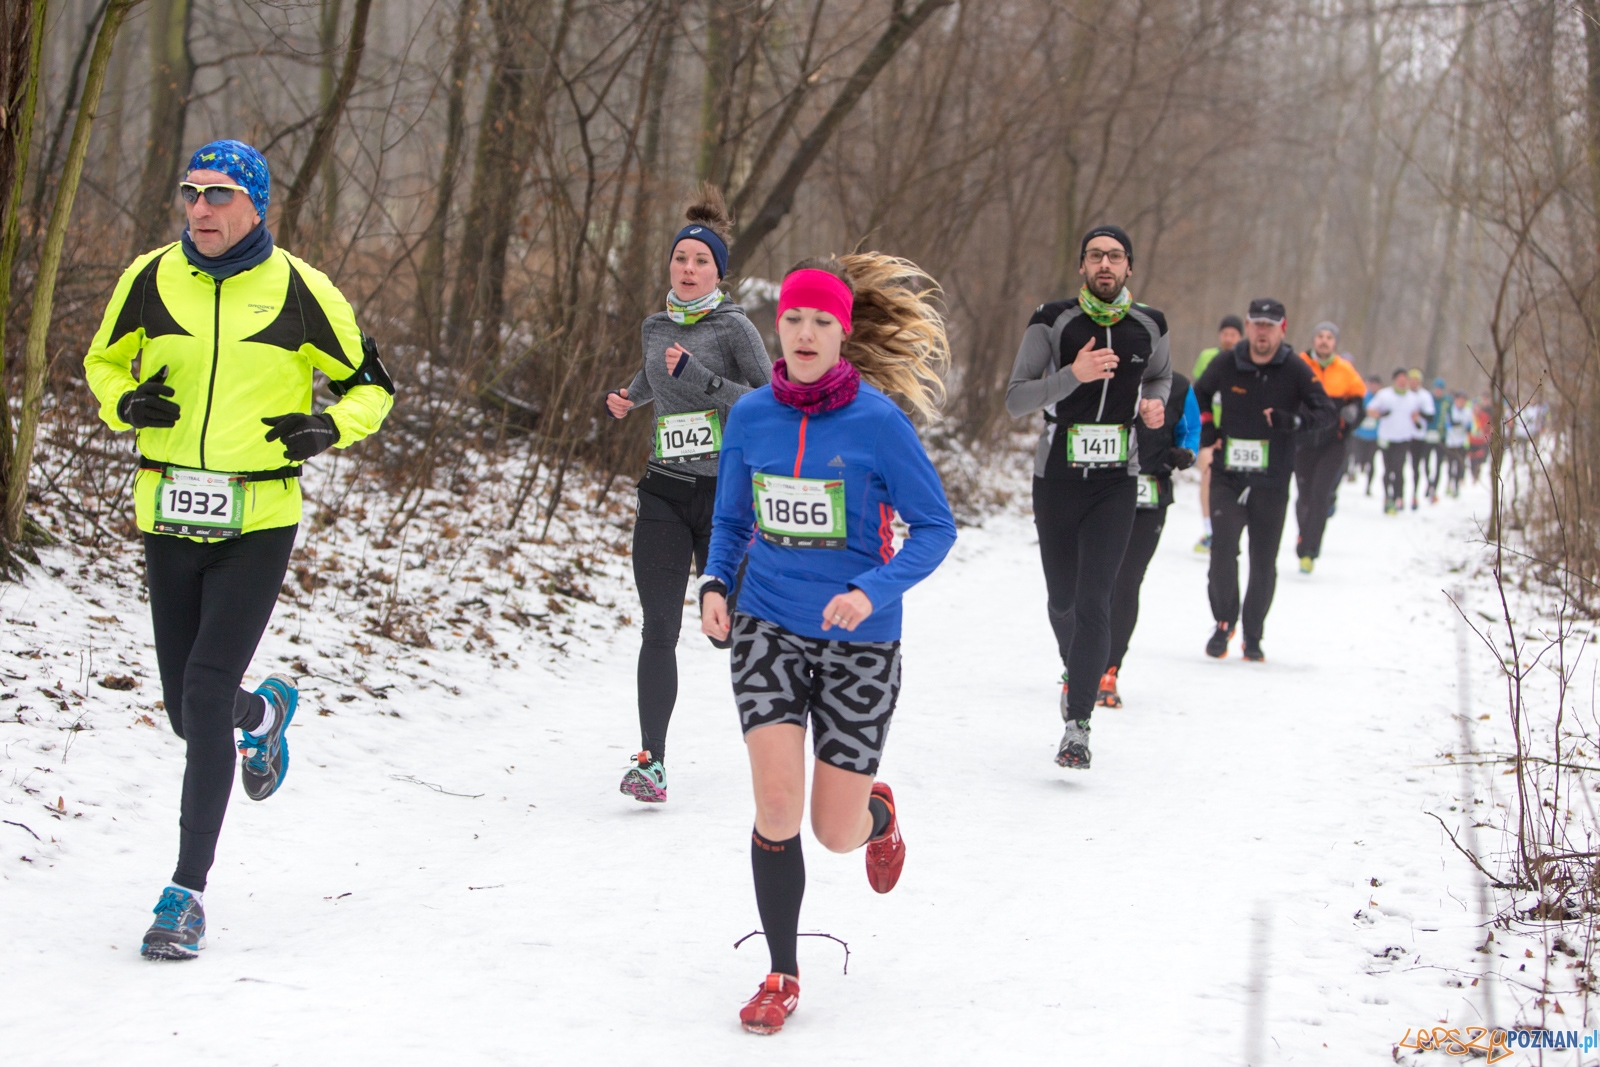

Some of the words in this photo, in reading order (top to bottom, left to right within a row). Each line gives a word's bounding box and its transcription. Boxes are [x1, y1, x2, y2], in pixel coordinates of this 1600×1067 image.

[663, 426, 714, 450] 1042
[1081, 438, 1116, 455] 1411
[1233, 448, 1260, 462] 536
[169, 489, 228, 517] 1932
[765, 497, 828, 526] 1866
